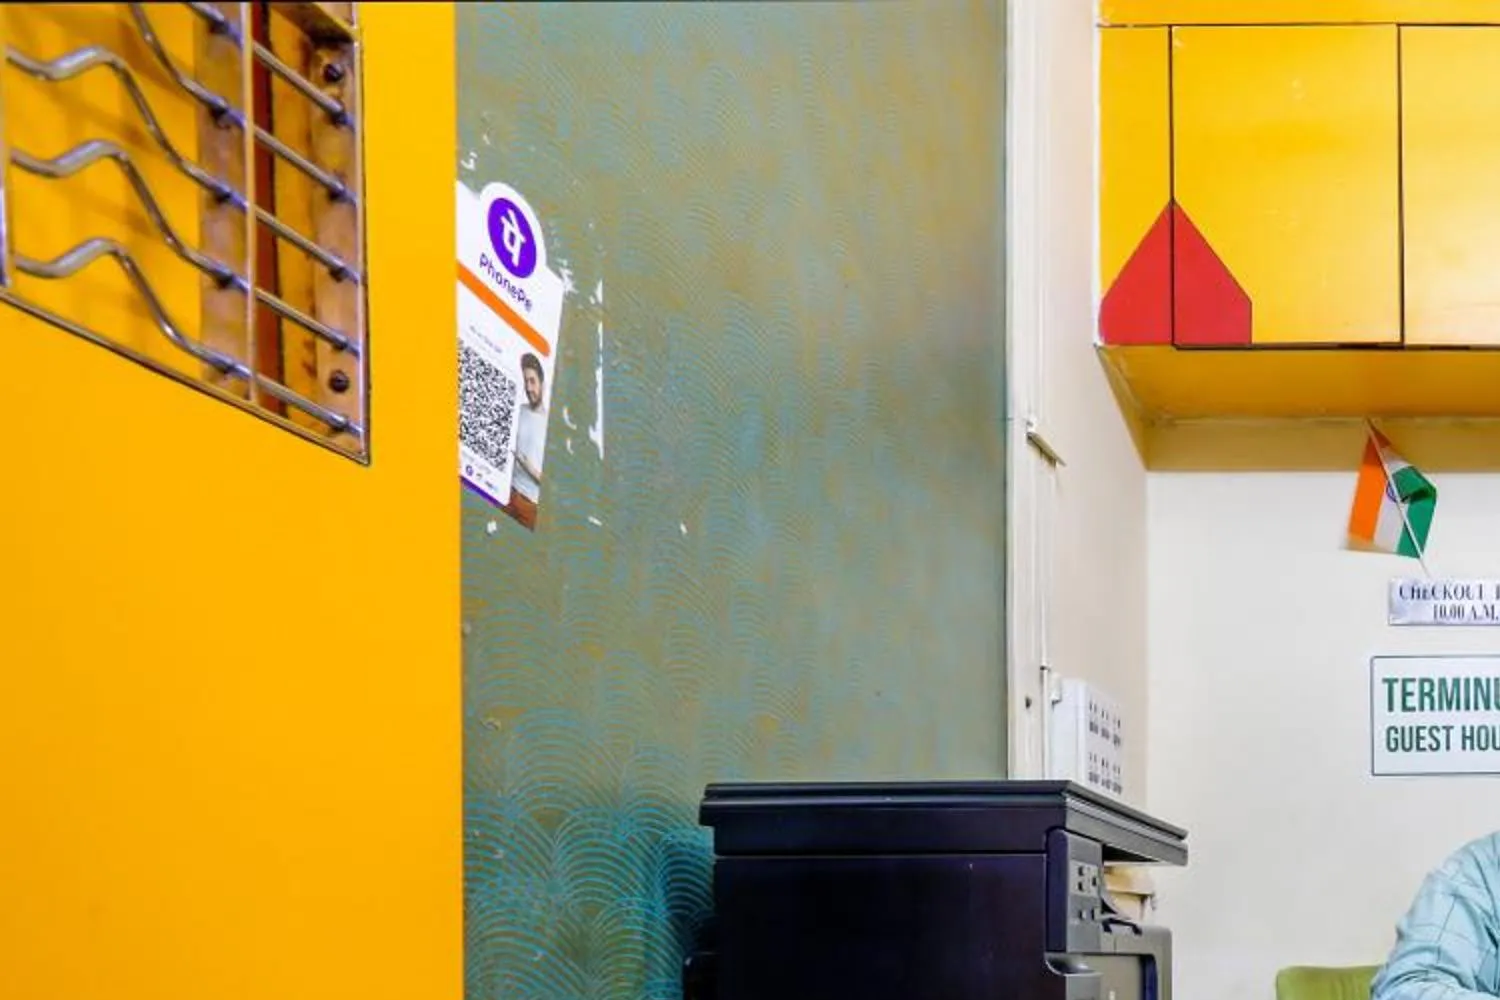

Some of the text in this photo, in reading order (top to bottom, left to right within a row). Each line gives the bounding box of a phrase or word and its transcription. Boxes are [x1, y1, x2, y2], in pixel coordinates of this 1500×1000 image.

[479, 252, 532, 312] PhonePe
[1399, 582, 1484, 601] CHECKOUT
[1468, 603, 1500, 622] A.M.
[1386, 725, 1455, 753] GUEST
